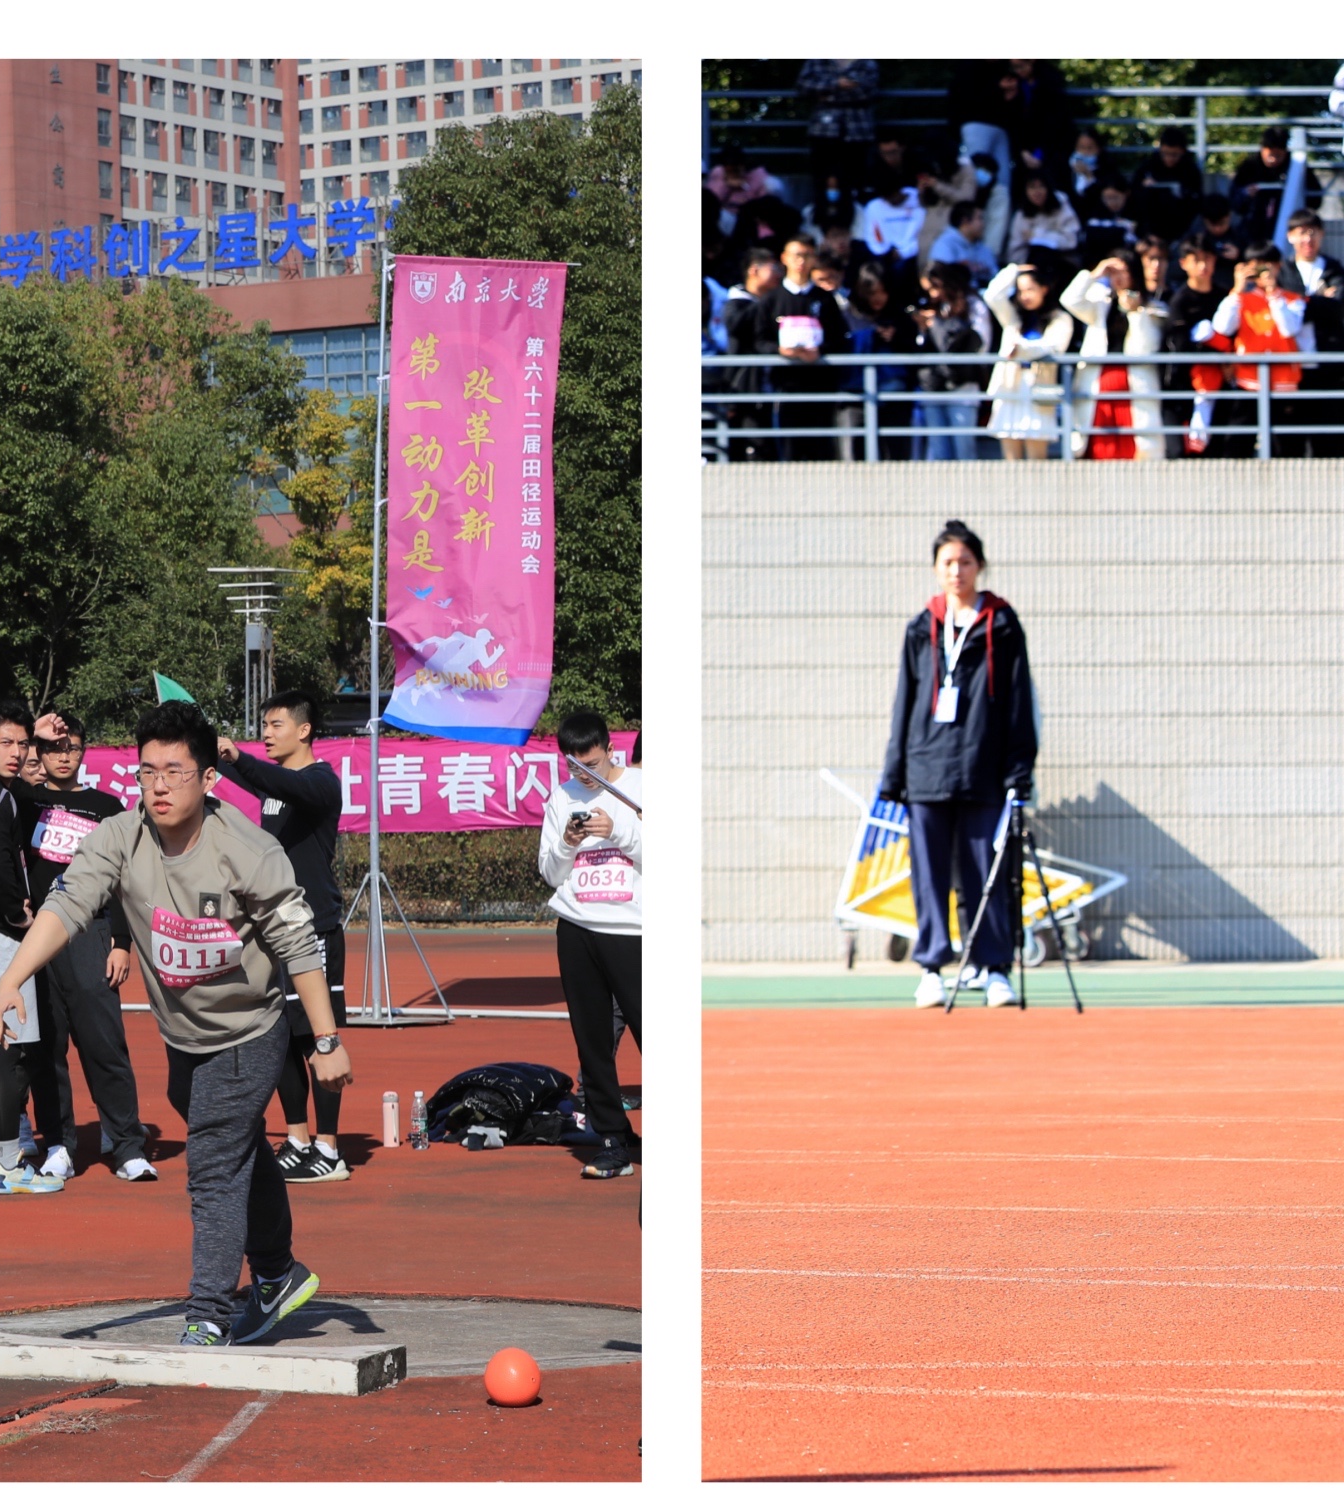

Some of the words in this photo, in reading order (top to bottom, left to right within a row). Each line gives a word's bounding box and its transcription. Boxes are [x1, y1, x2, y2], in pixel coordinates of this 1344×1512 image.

[400, 332, 445, 573] 第一动力是
[453, 365, 503, 551] 改革创新
[520, 336, 545, 575] 第六十二届田径运动会
[415, 668, 508, 691] RUNNING
[578, 869, 626, 887] 0634
[159, 943, 229, 969] 0111
